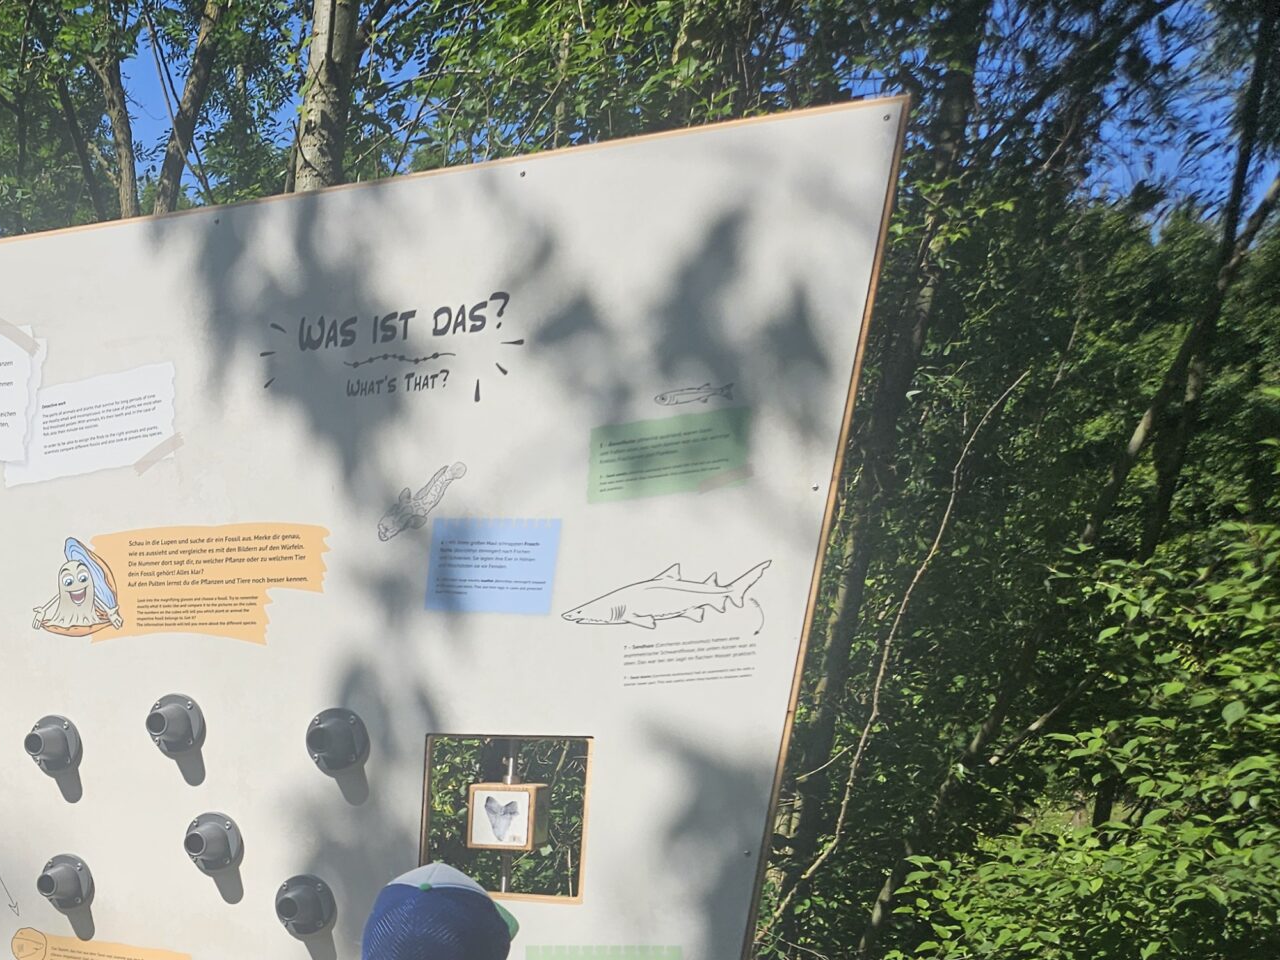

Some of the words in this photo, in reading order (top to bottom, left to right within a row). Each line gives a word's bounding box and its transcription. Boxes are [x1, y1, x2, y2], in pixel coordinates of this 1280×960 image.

[299, 316, 357, 351] WAS
[372, 310, 417, 344] IST
[432, 291, 510, 337] DAS?
[347, 376, 397, 397] WHAT'S
[404, 369, 450, 392] THAT?
[161, 538, 177, 546] Lupen
[146, 548, 168, 556] aussieht
[174, 558, 184, 567] sagt
[156, 569, 175, 577] gehört!
[201, 577, 224, 585] Pflanzen
